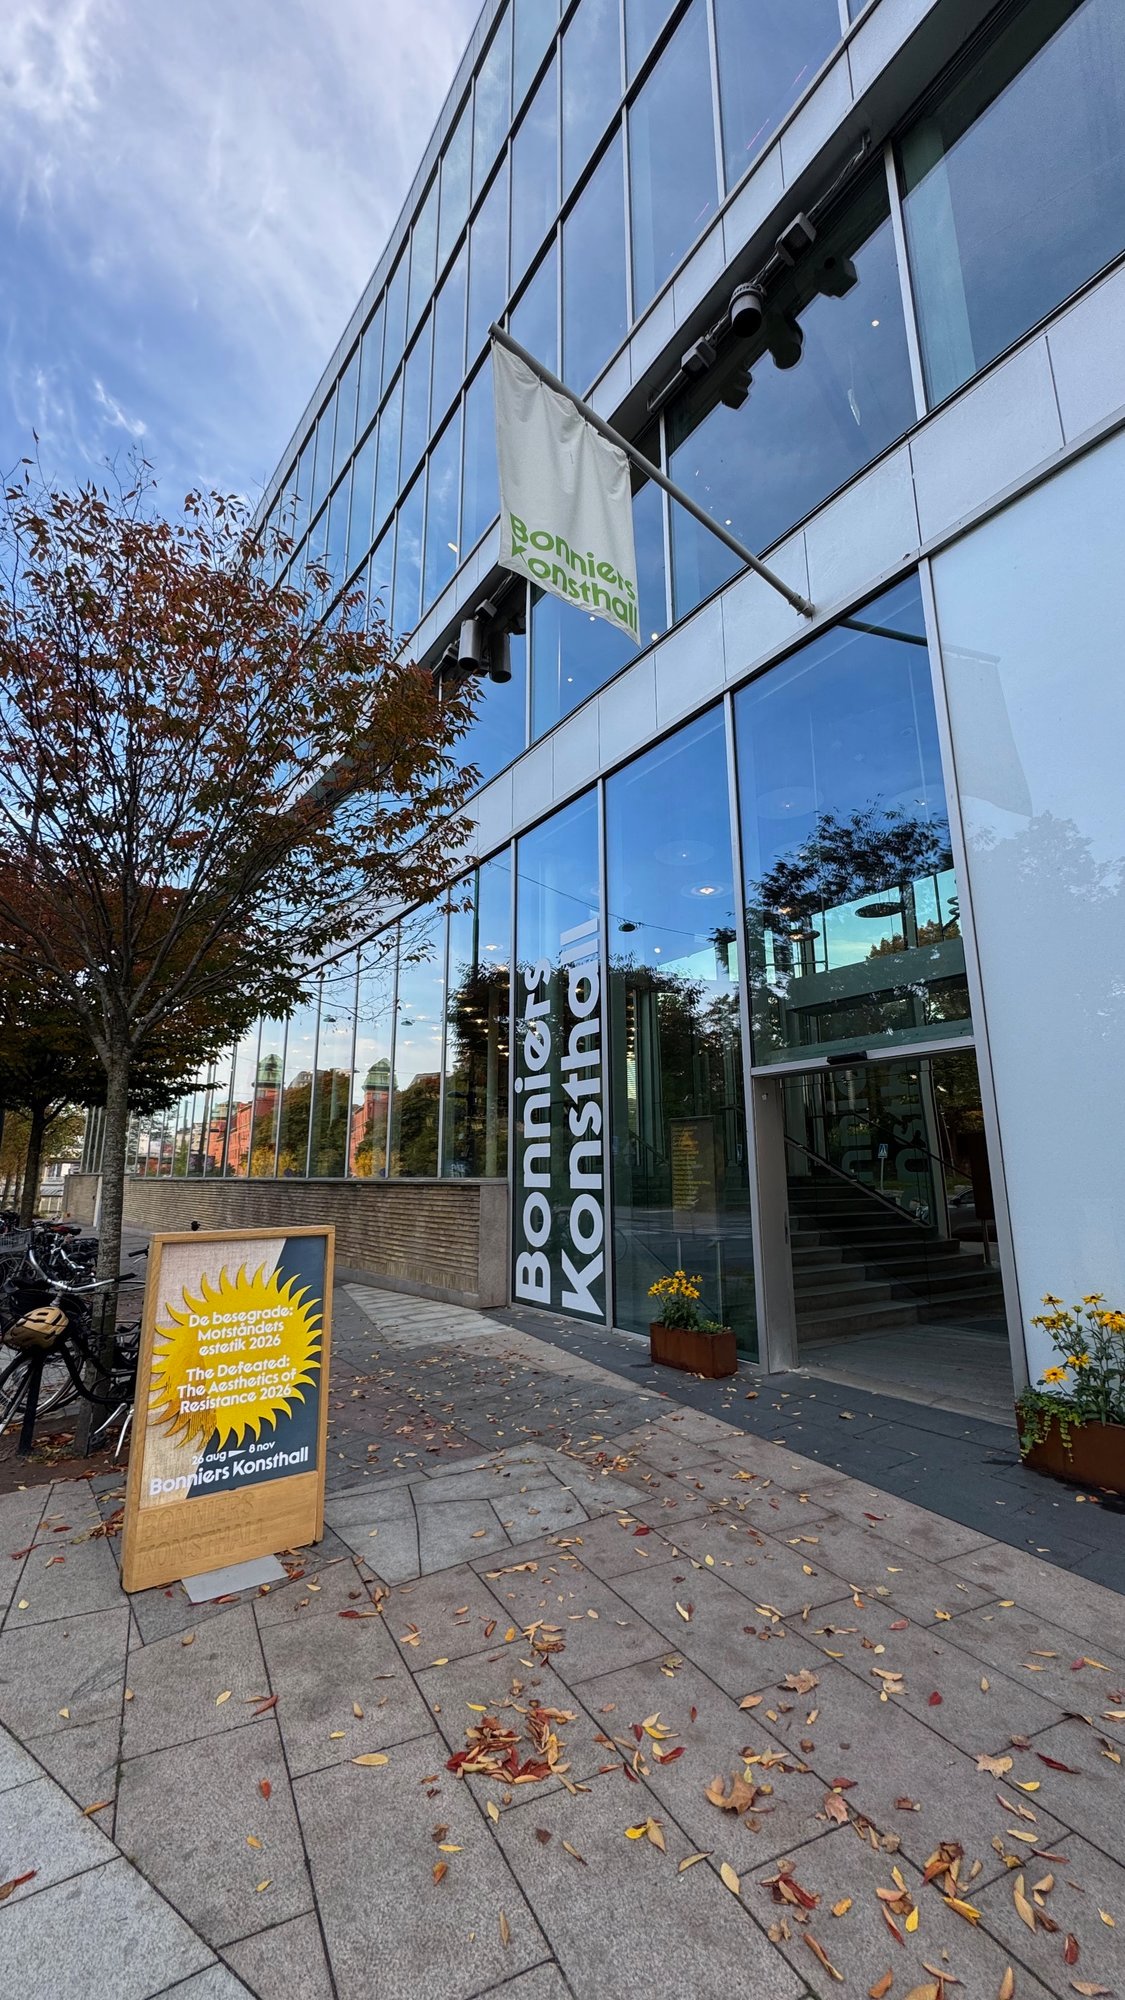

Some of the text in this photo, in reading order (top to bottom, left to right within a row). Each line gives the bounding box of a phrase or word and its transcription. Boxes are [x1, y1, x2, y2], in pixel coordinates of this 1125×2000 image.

[510, 512, 636, 600] Bonniers
[514, 957, 551, 1304] Bonniers
[560, 918, 604, 1316] Konsthall
[189, 1305, 294, 1327] De besegrade:
[198, 1321, 285, 1341] Motståndets
[199, 1334, 281, 1356] estetik 2026
[177, 1368, 297, 1399] The Aesthetics of
[186, 1355, 290, 1382] The Defeated:
[180, 1384, 292, 1415] Resistance 2026
[191, 1441, 276, 1466] 26 aug 8 nov
[149, 1446, 309, 1496] Bonniers Konsthall
[141, 1492, 254, 1542] BONNIERS
